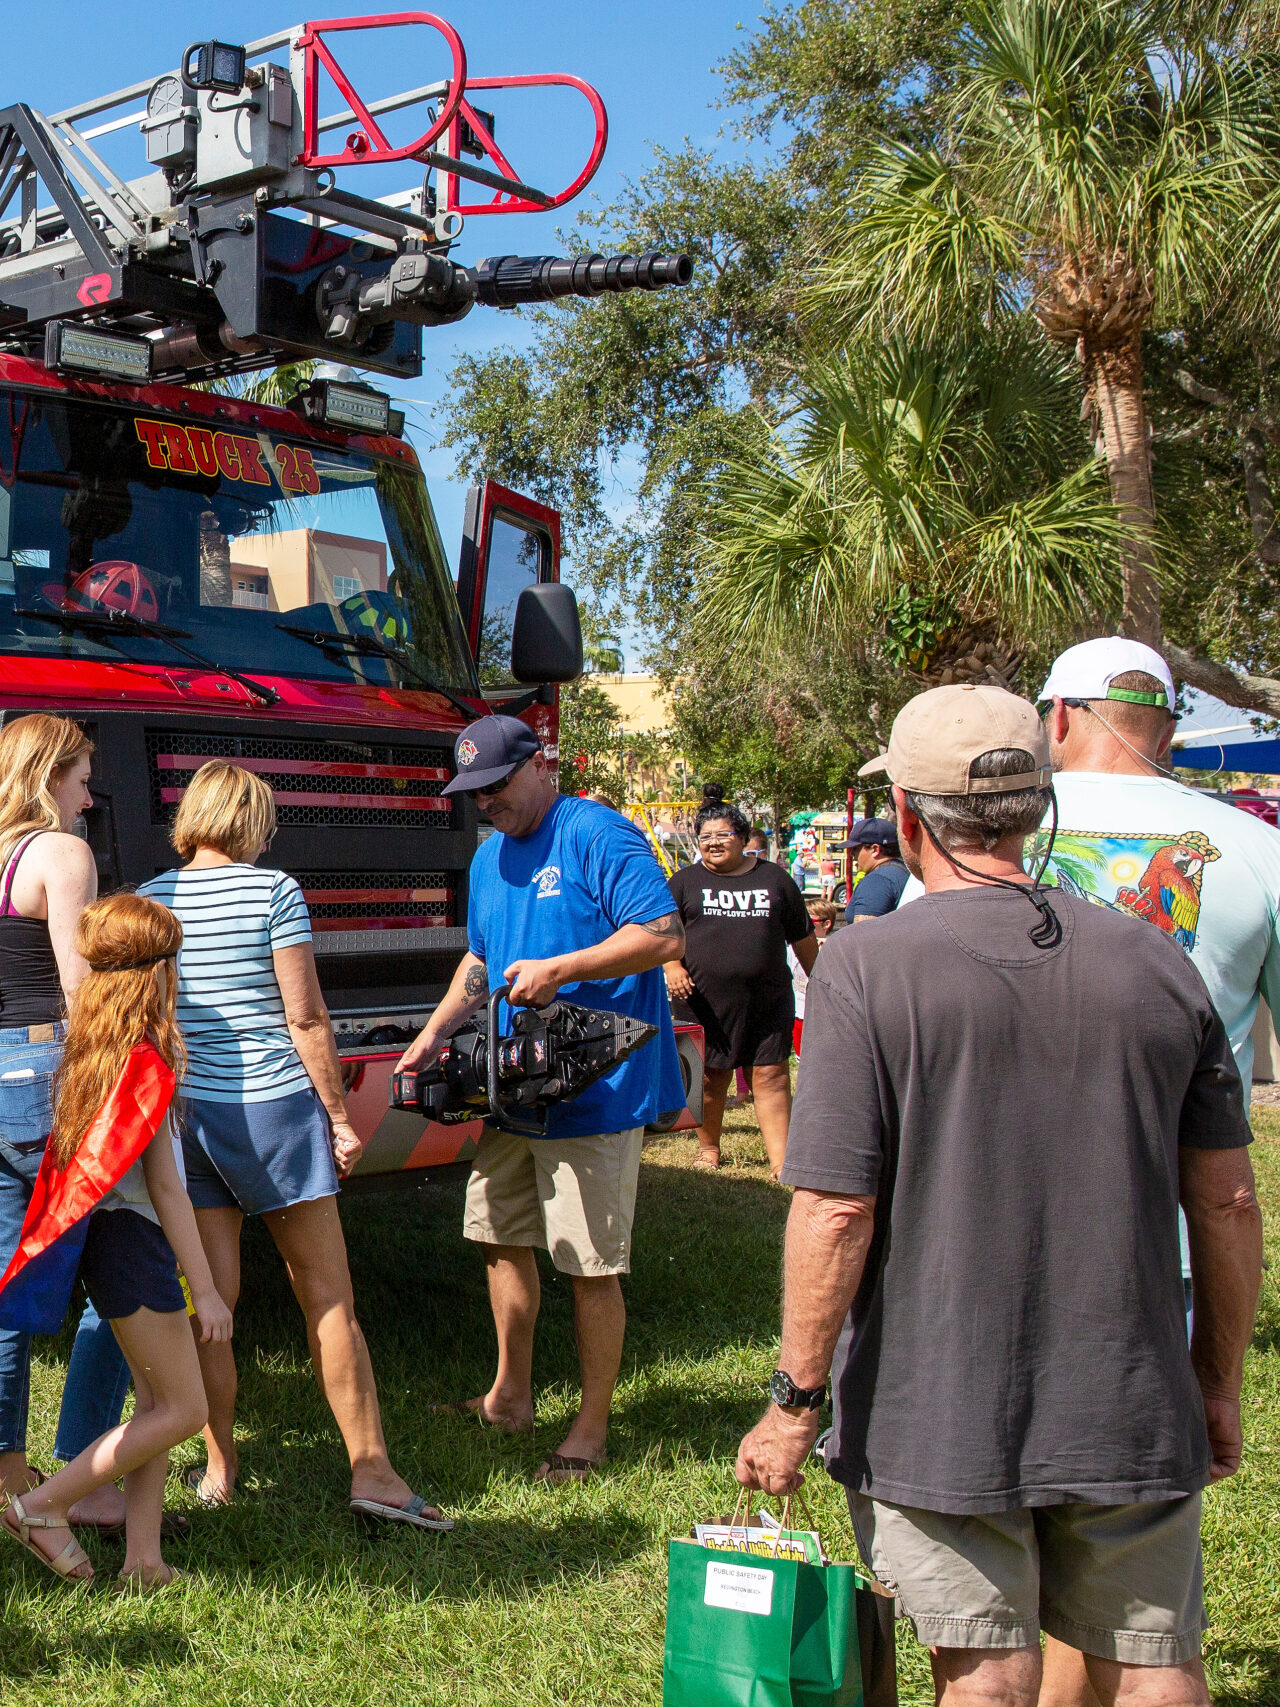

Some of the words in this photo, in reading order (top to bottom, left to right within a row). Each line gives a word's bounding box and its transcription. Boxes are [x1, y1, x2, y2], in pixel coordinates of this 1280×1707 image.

[134, 418, 271, 485] TRUCK
[275, 443, 320, 495] 25
[702, 888, 771, 910] LOVE
[704, 908, 722, 916] LOVE
[727, 910, 746, 918] LOVE
[752, 909, 770, 917] LOVE
[713, 1567, 735, 1576] PUBLIC
[736, 1571, 757, 1579] SAFETY
